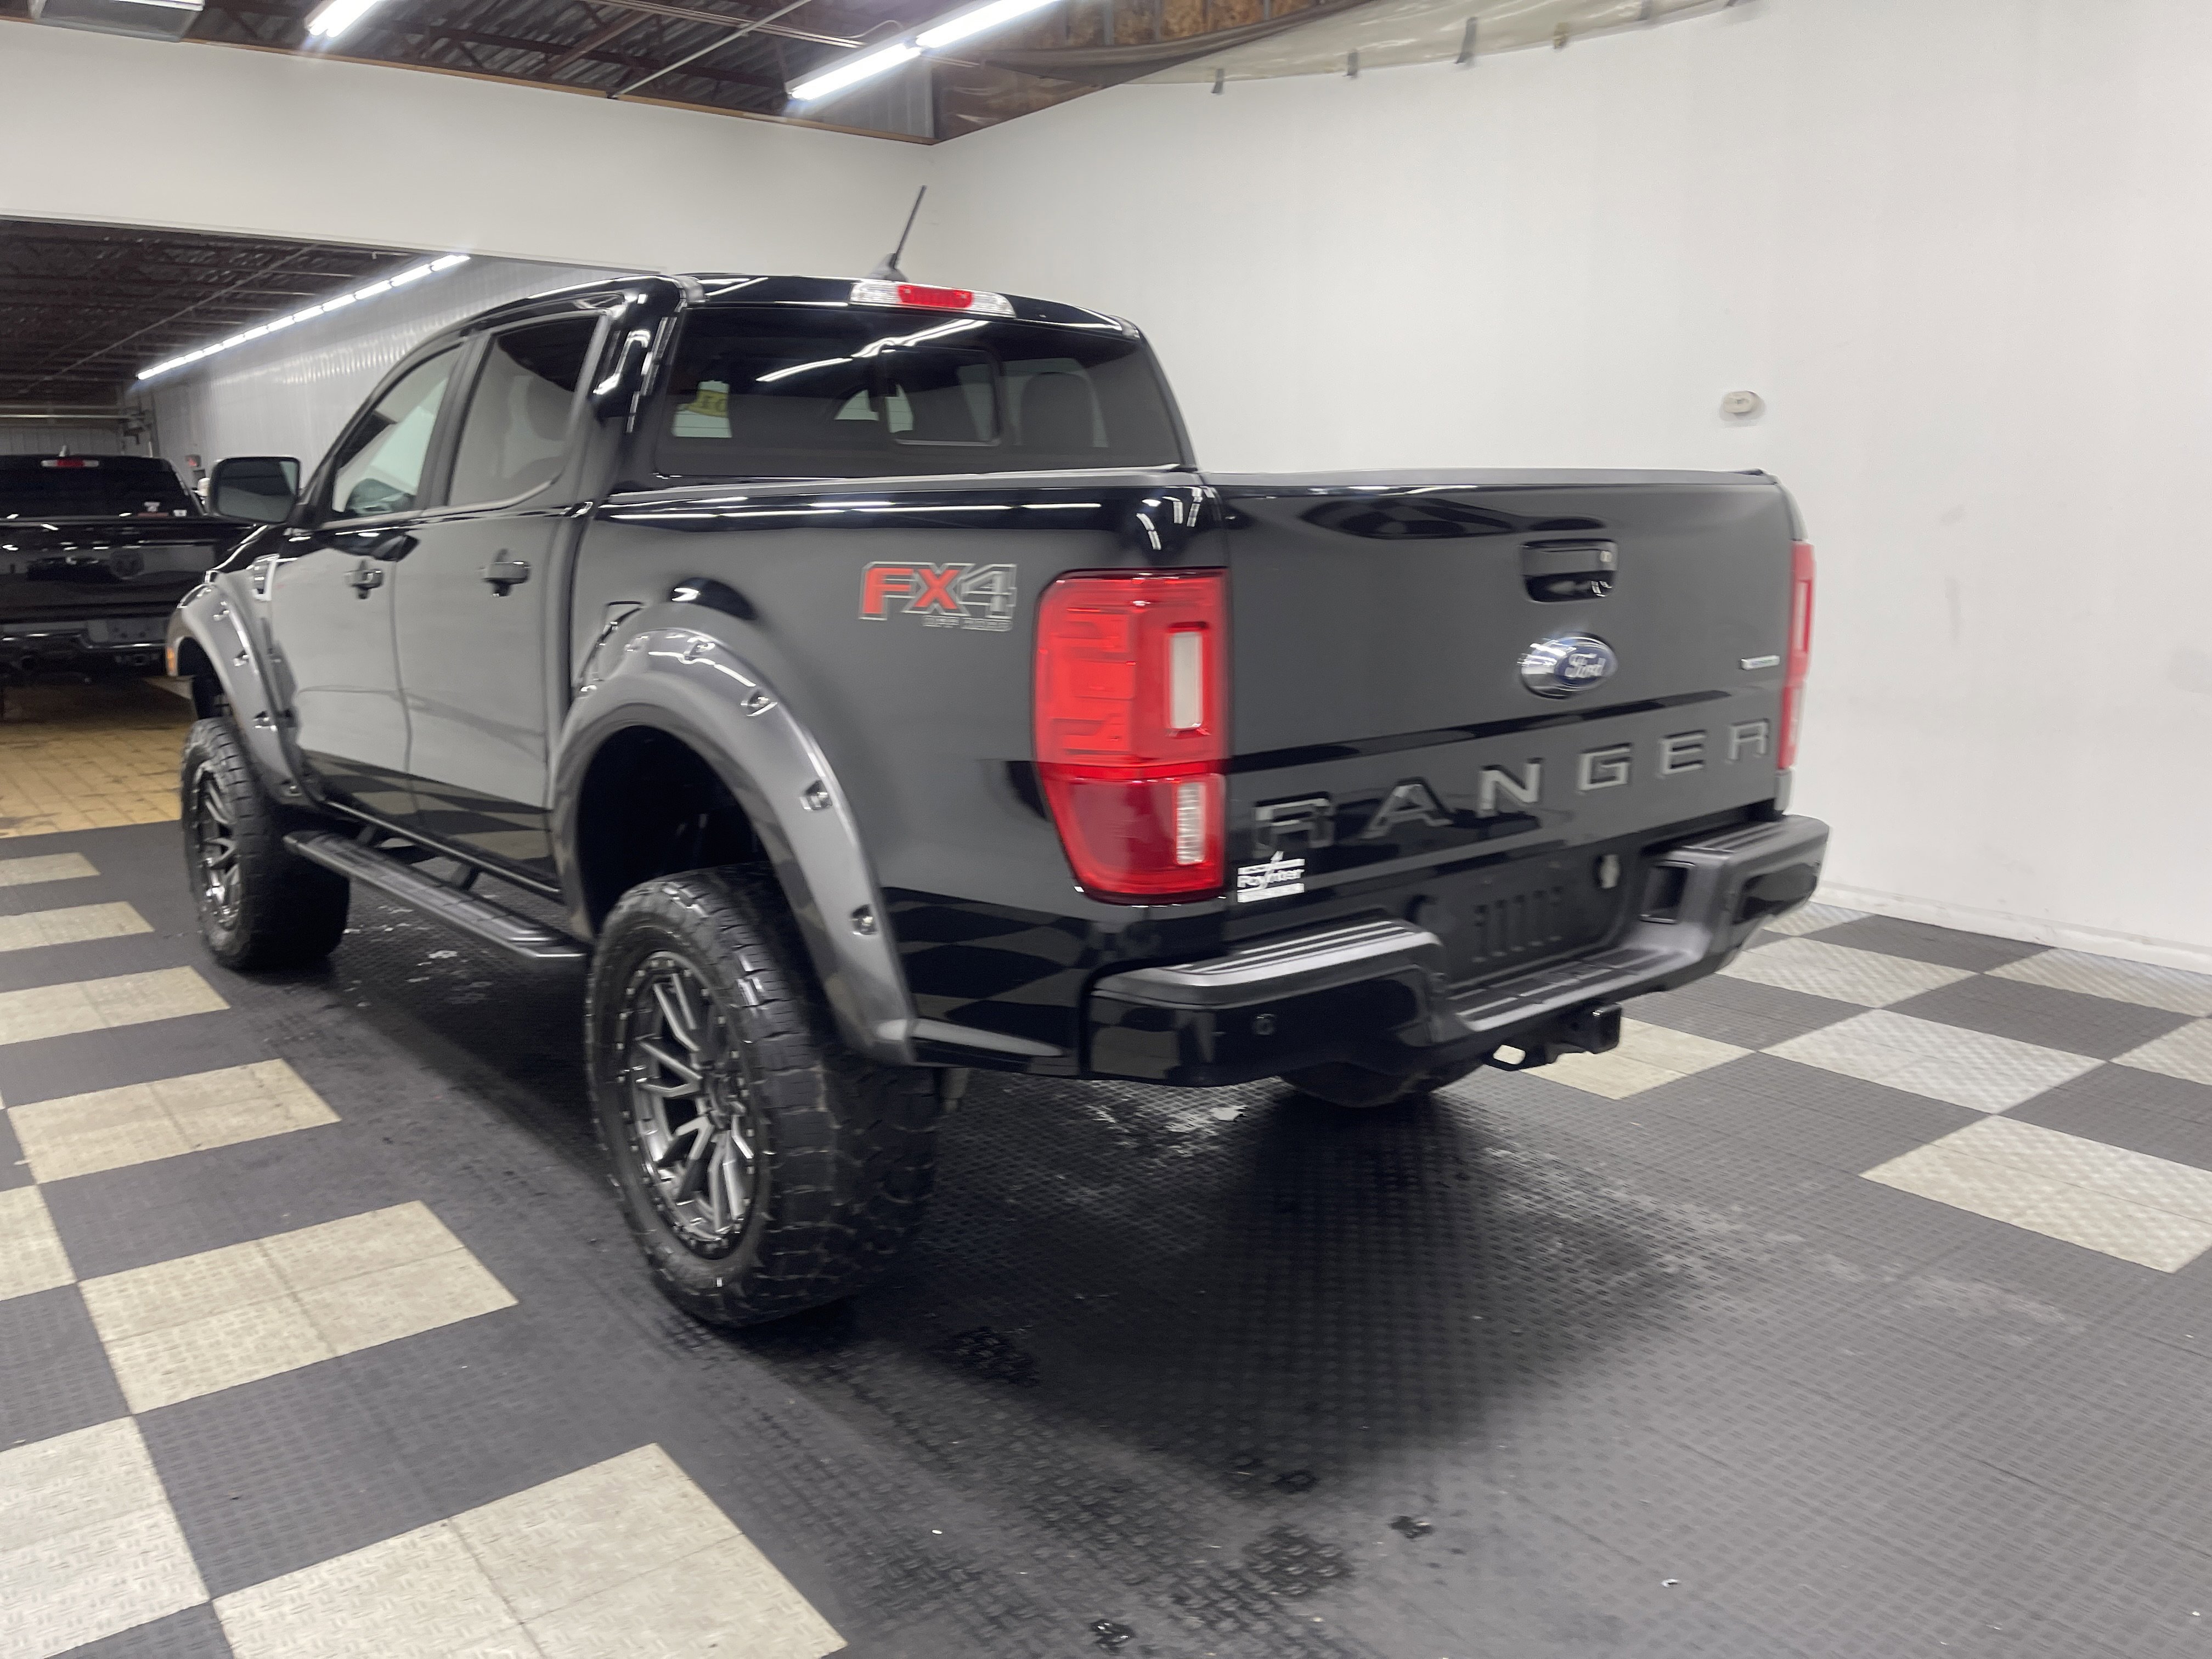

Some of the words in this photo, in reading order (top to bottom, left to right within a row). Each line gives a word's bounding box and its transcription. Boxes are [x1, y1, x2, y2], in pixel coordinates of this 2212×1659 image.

[859, 561, 1017, 620] FX4
[1565, 653, 1606, 678] Ford
[1253, 718, 1770, 857] RANGER
